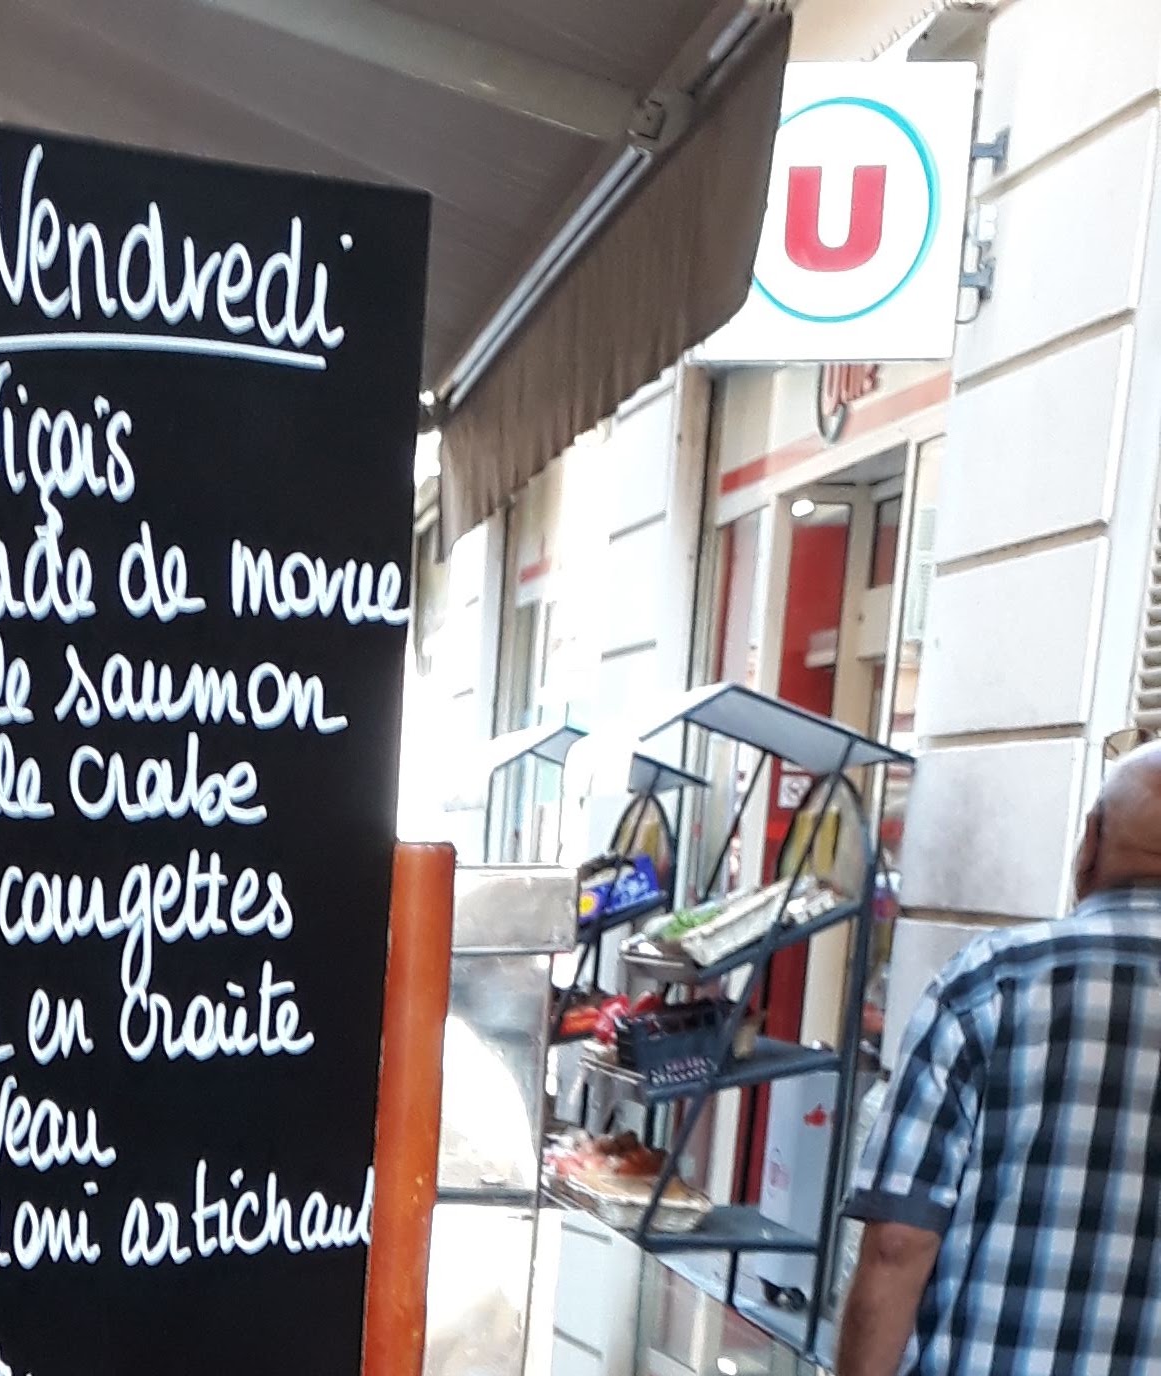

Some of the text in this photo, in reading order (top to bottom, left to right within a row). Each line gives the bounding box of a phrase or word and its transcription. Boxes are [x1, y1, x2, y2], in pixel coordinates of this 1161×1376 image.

[783, 165, 887, 272] U
[119, 521, 206, 621] de
[232, 538, 410, 624] morue
[55, 645, 348, 733] saumon
[70, 732, 267, 825] crabe
[28, 989, 93, 1064] en
